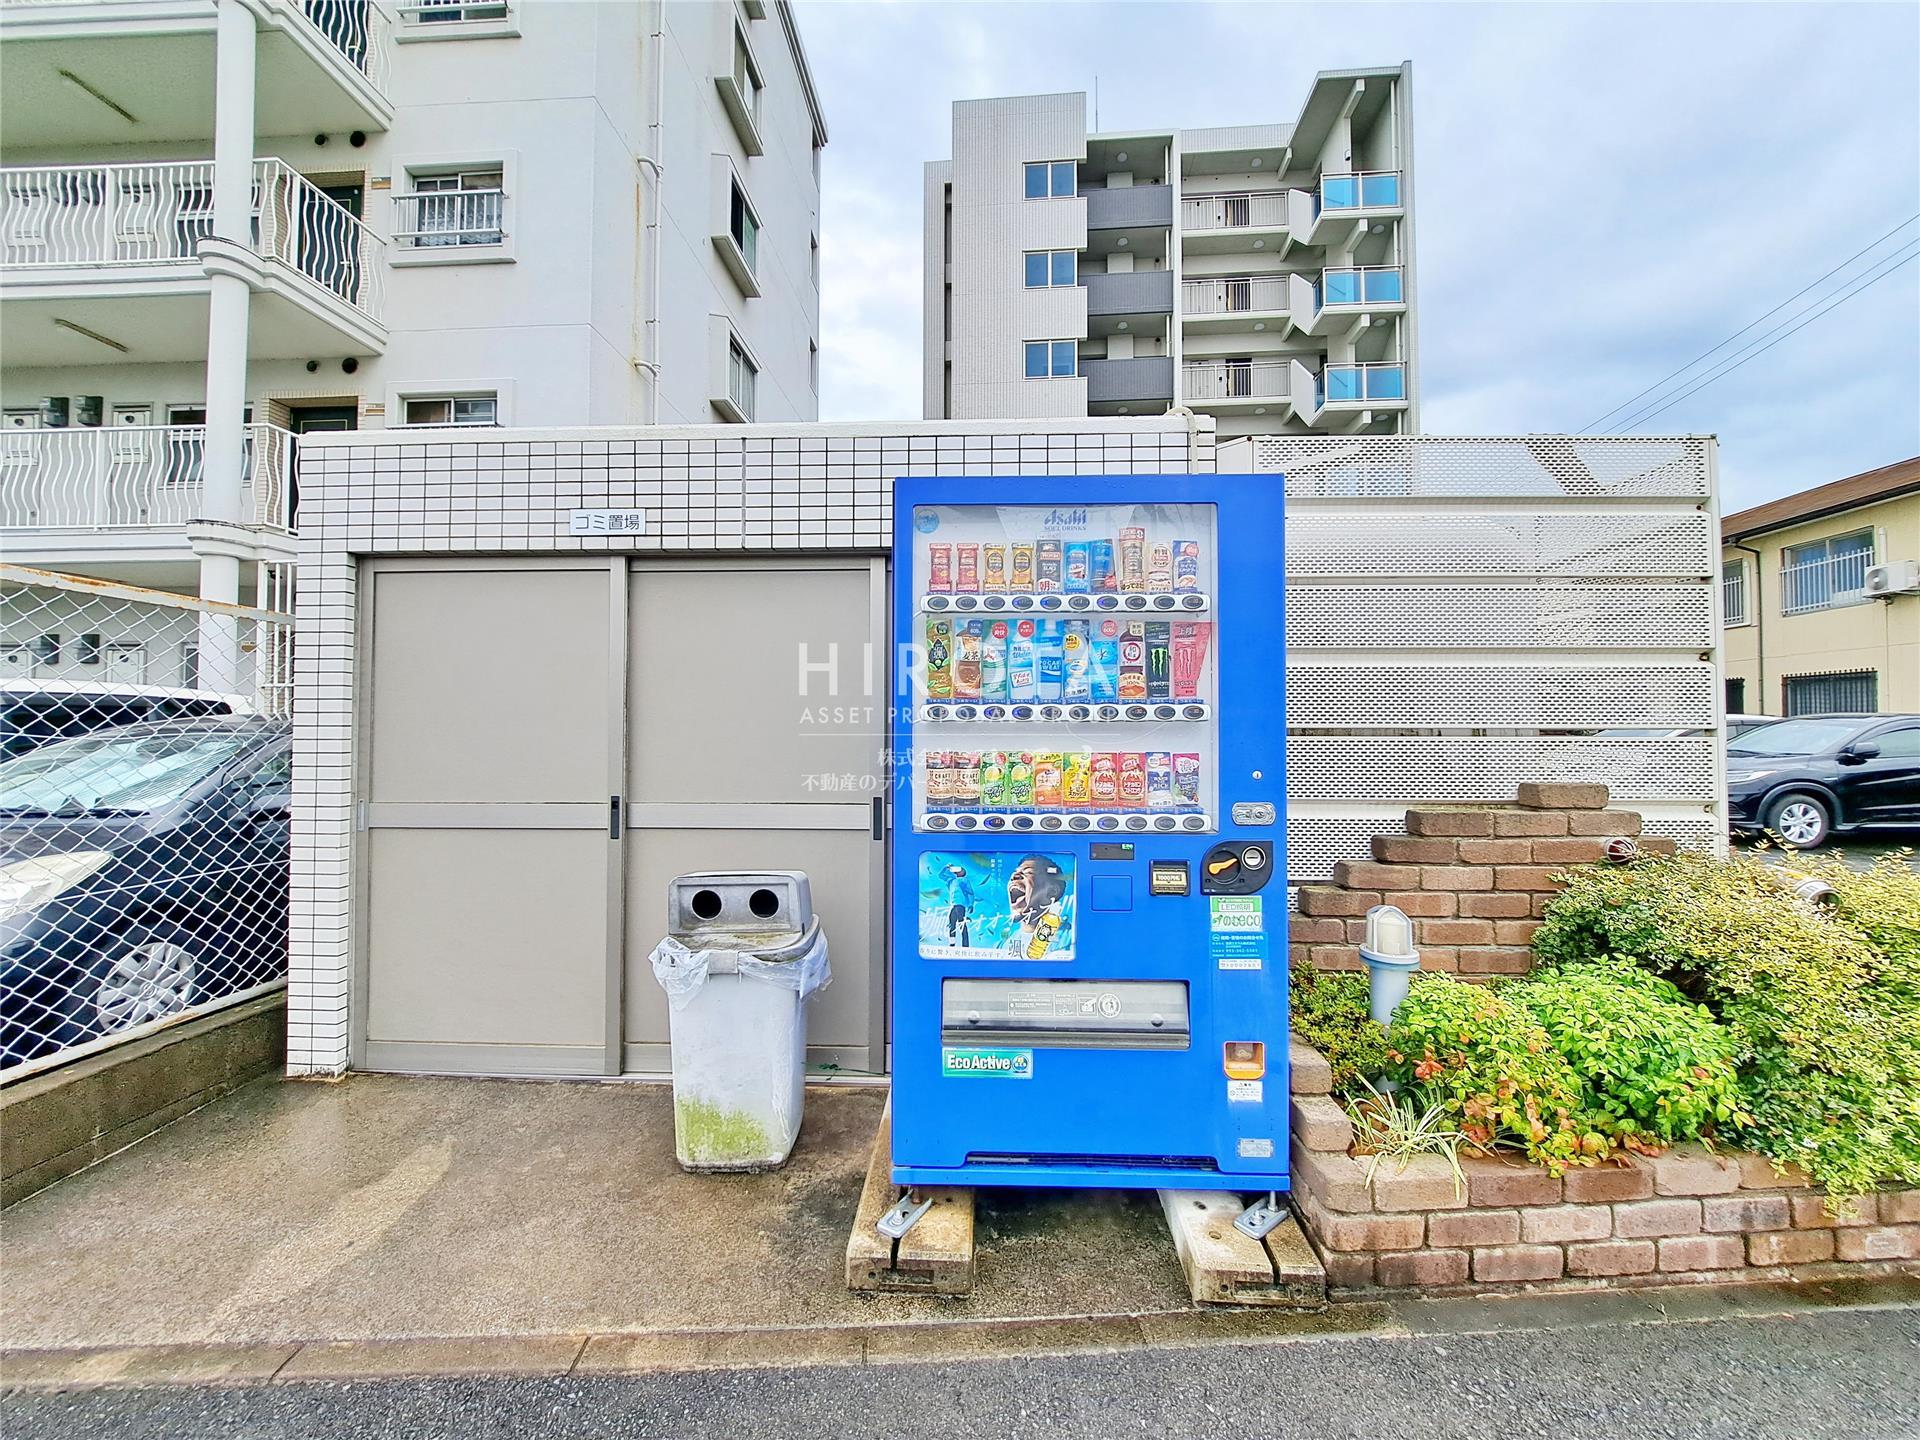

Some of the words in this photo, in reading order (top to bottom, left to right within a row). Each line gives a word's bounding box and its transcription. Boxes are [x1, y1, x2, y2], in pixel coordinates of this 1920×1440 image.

[575, 514, 640, 530] ゴミ置場
[1044, 508, 1087, 525] Asahi
